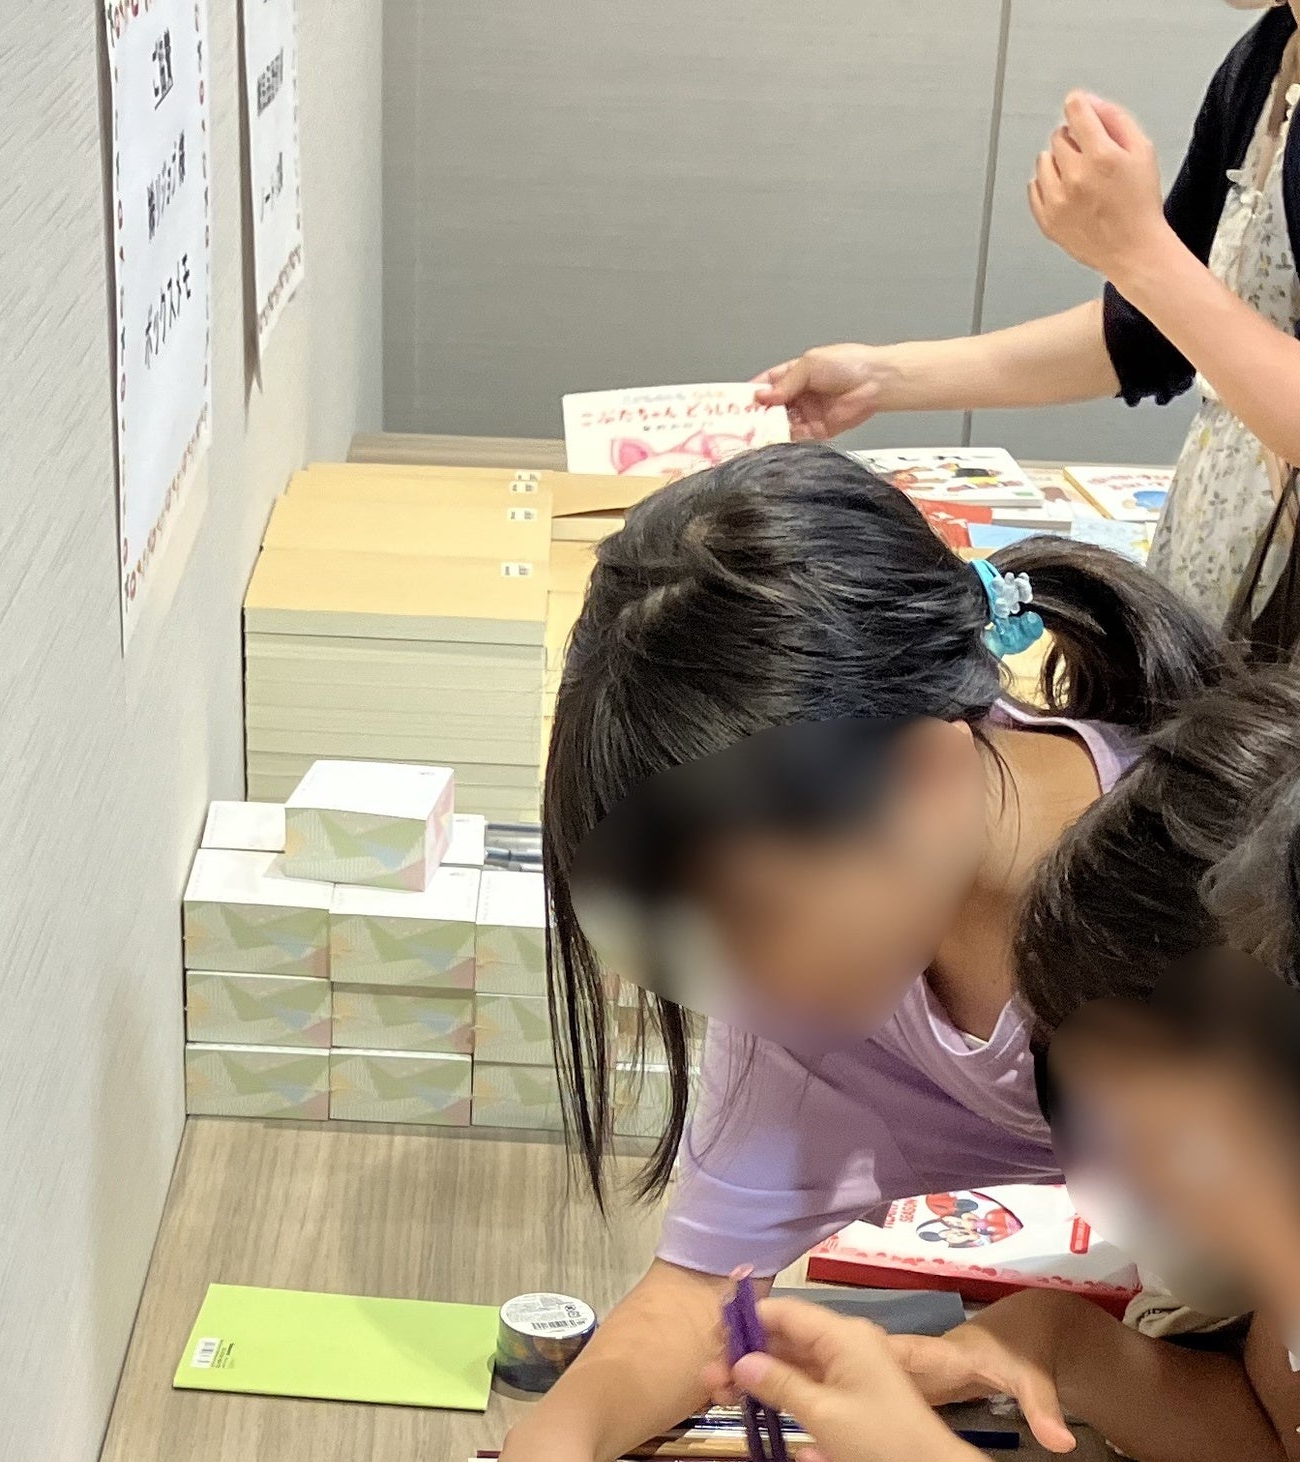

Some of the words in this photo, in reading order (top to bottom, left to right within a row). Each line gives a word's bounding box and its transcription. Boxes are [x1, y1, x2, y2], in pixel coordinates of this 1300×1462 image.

[144, 253, 191, 368] ボックスメモ
